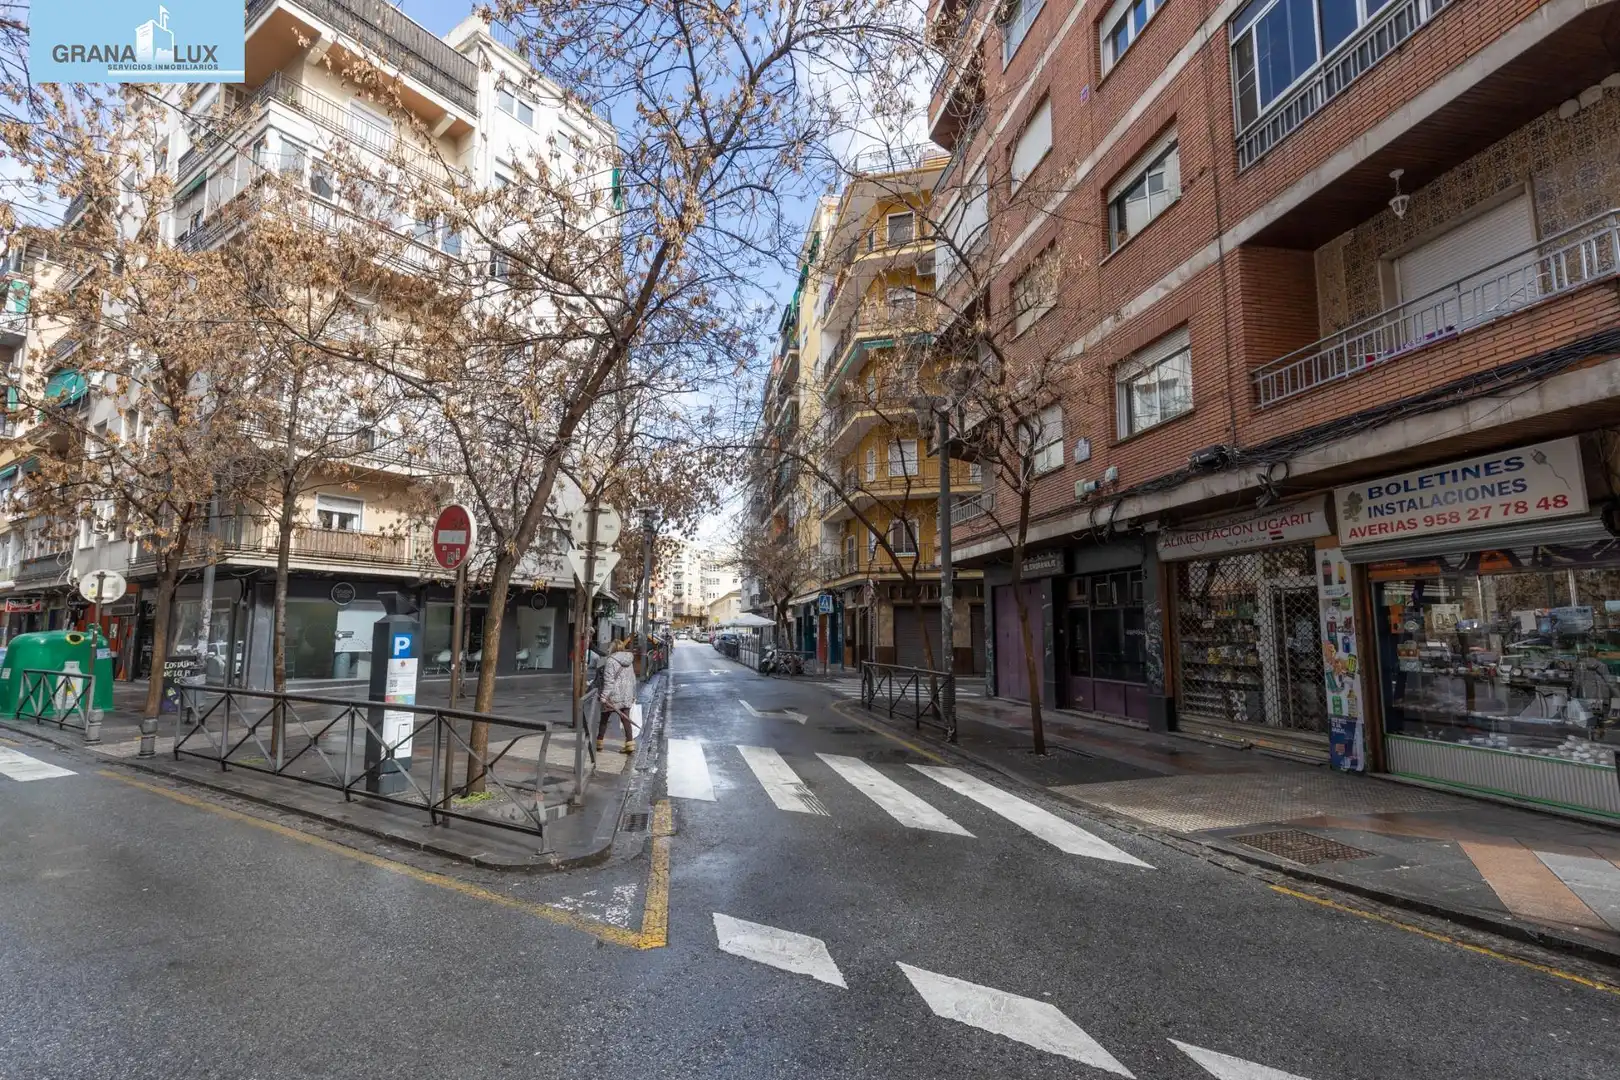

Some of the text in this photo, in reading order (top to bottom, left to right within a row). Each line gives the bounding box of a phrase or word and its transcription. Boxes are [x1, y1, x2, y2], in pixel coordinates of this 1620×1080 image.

[1367, 456, 1525, 500] BOLETINES
[1367, 477, 1528, 518] INSTALACIONES
[1163, 524, 1253, 549] ALIMENTACION
[1257, 511, 1315, 532] UGARIT
[1349, 494, 1569, 539] AVERIAS 958 27 78 48
[393, 636, 411, 656] P
